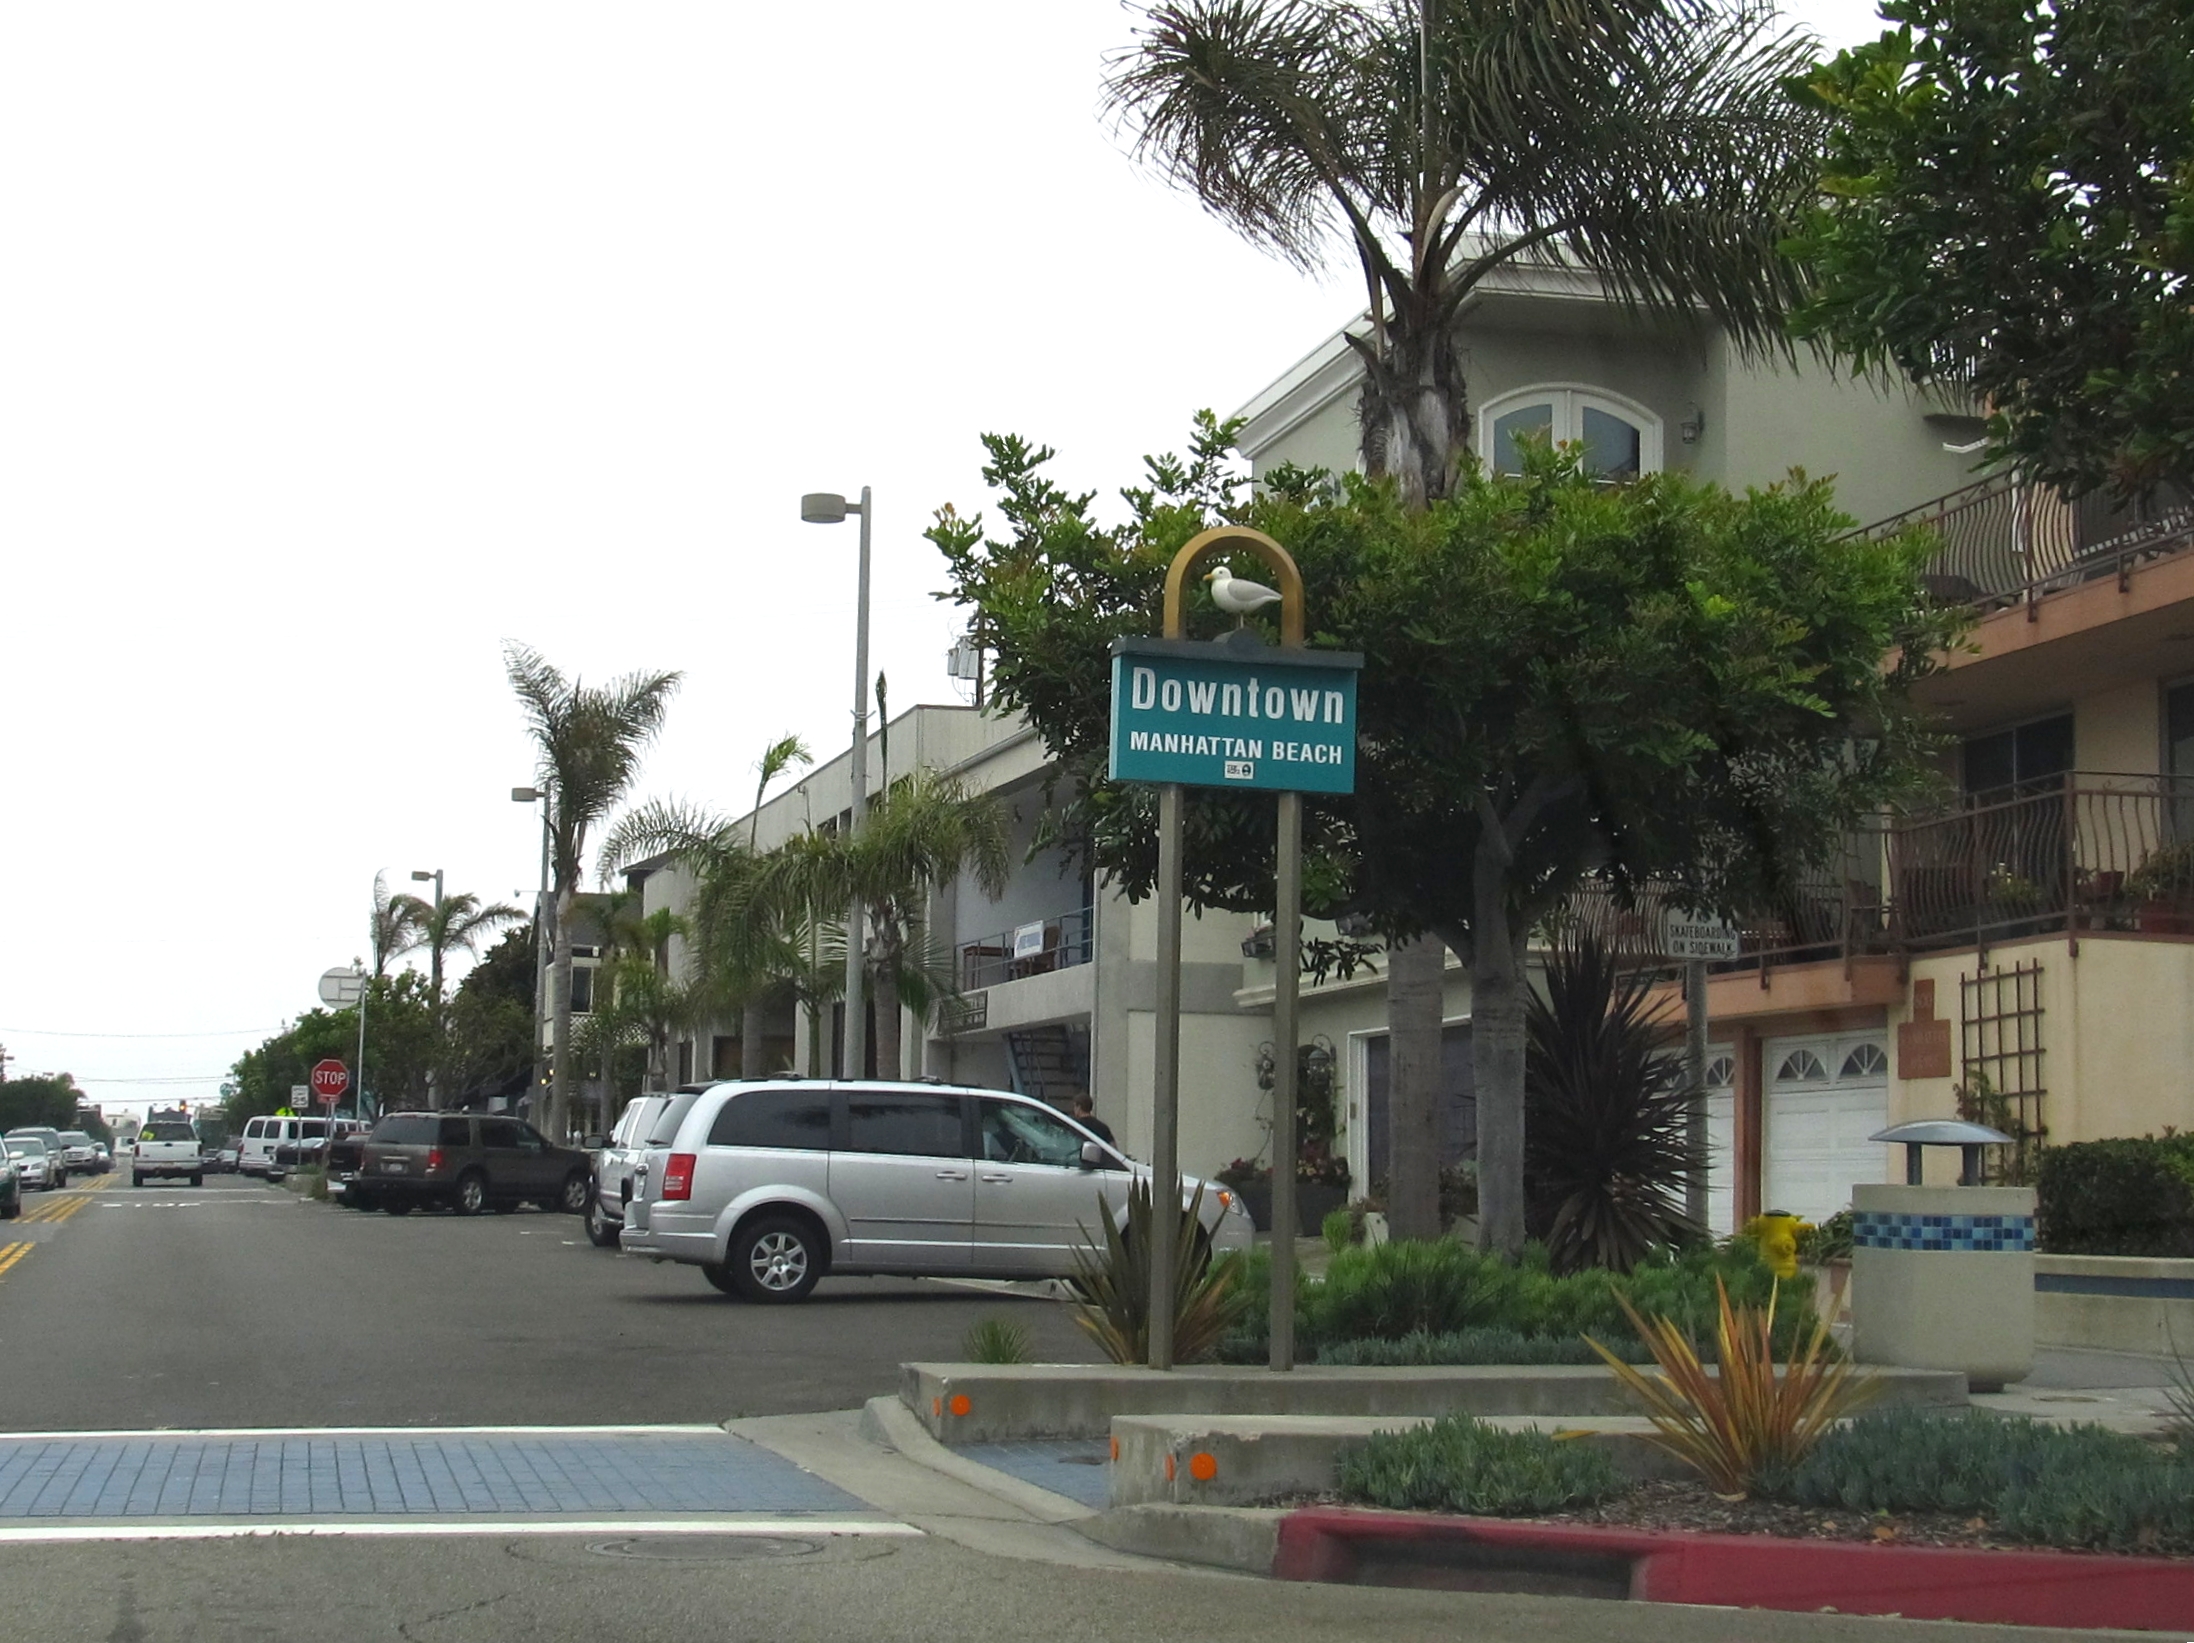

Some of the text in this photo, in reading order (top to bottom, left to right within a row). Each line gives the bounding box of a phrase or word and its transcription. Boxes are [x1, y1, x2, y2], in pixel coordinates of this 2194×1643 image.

[1131, 666, 1344, 723] Downtown
[1130, 731, 1342, 764] MANHATTAN BEACH
[1670, 925, 1736, 940] SKATEBOARDING
[1673, 940, 1732, 954] ON SIDEWALK
[316, 1070, 346, 1084] STOP
[292, 1097, 308, 1106] 25
